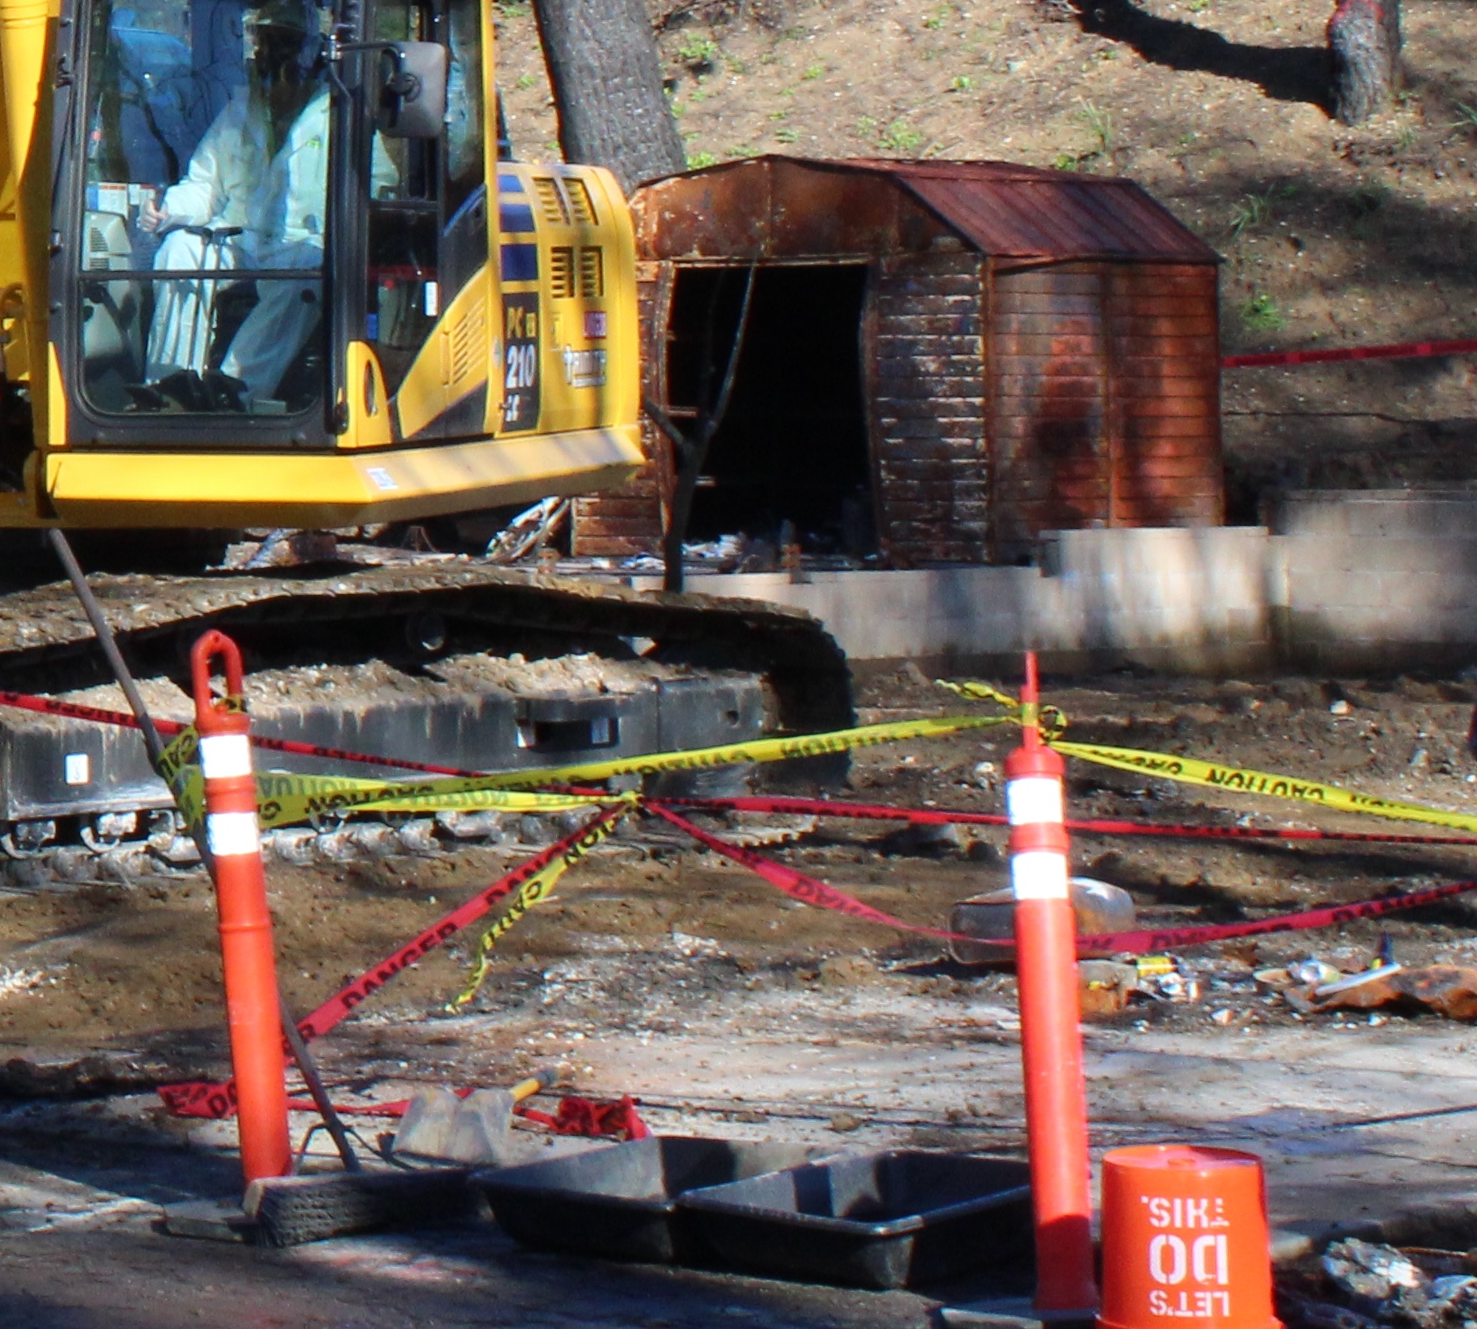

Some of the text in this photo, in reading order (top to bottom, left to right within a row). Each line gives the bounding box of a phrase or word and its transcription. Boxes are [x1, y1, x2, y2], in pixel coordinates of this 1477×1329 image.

[506, 344, 536, 389] 210
[1204, 767, 1326, 802] CAUTION
[341, 922, 457, 1011] DANGER
[1141, 1196, 1230, 1228] THIS.
[1149, 1234, 1229, 1285] DO
[1149, 1290, 1230, 1318] LET'S
